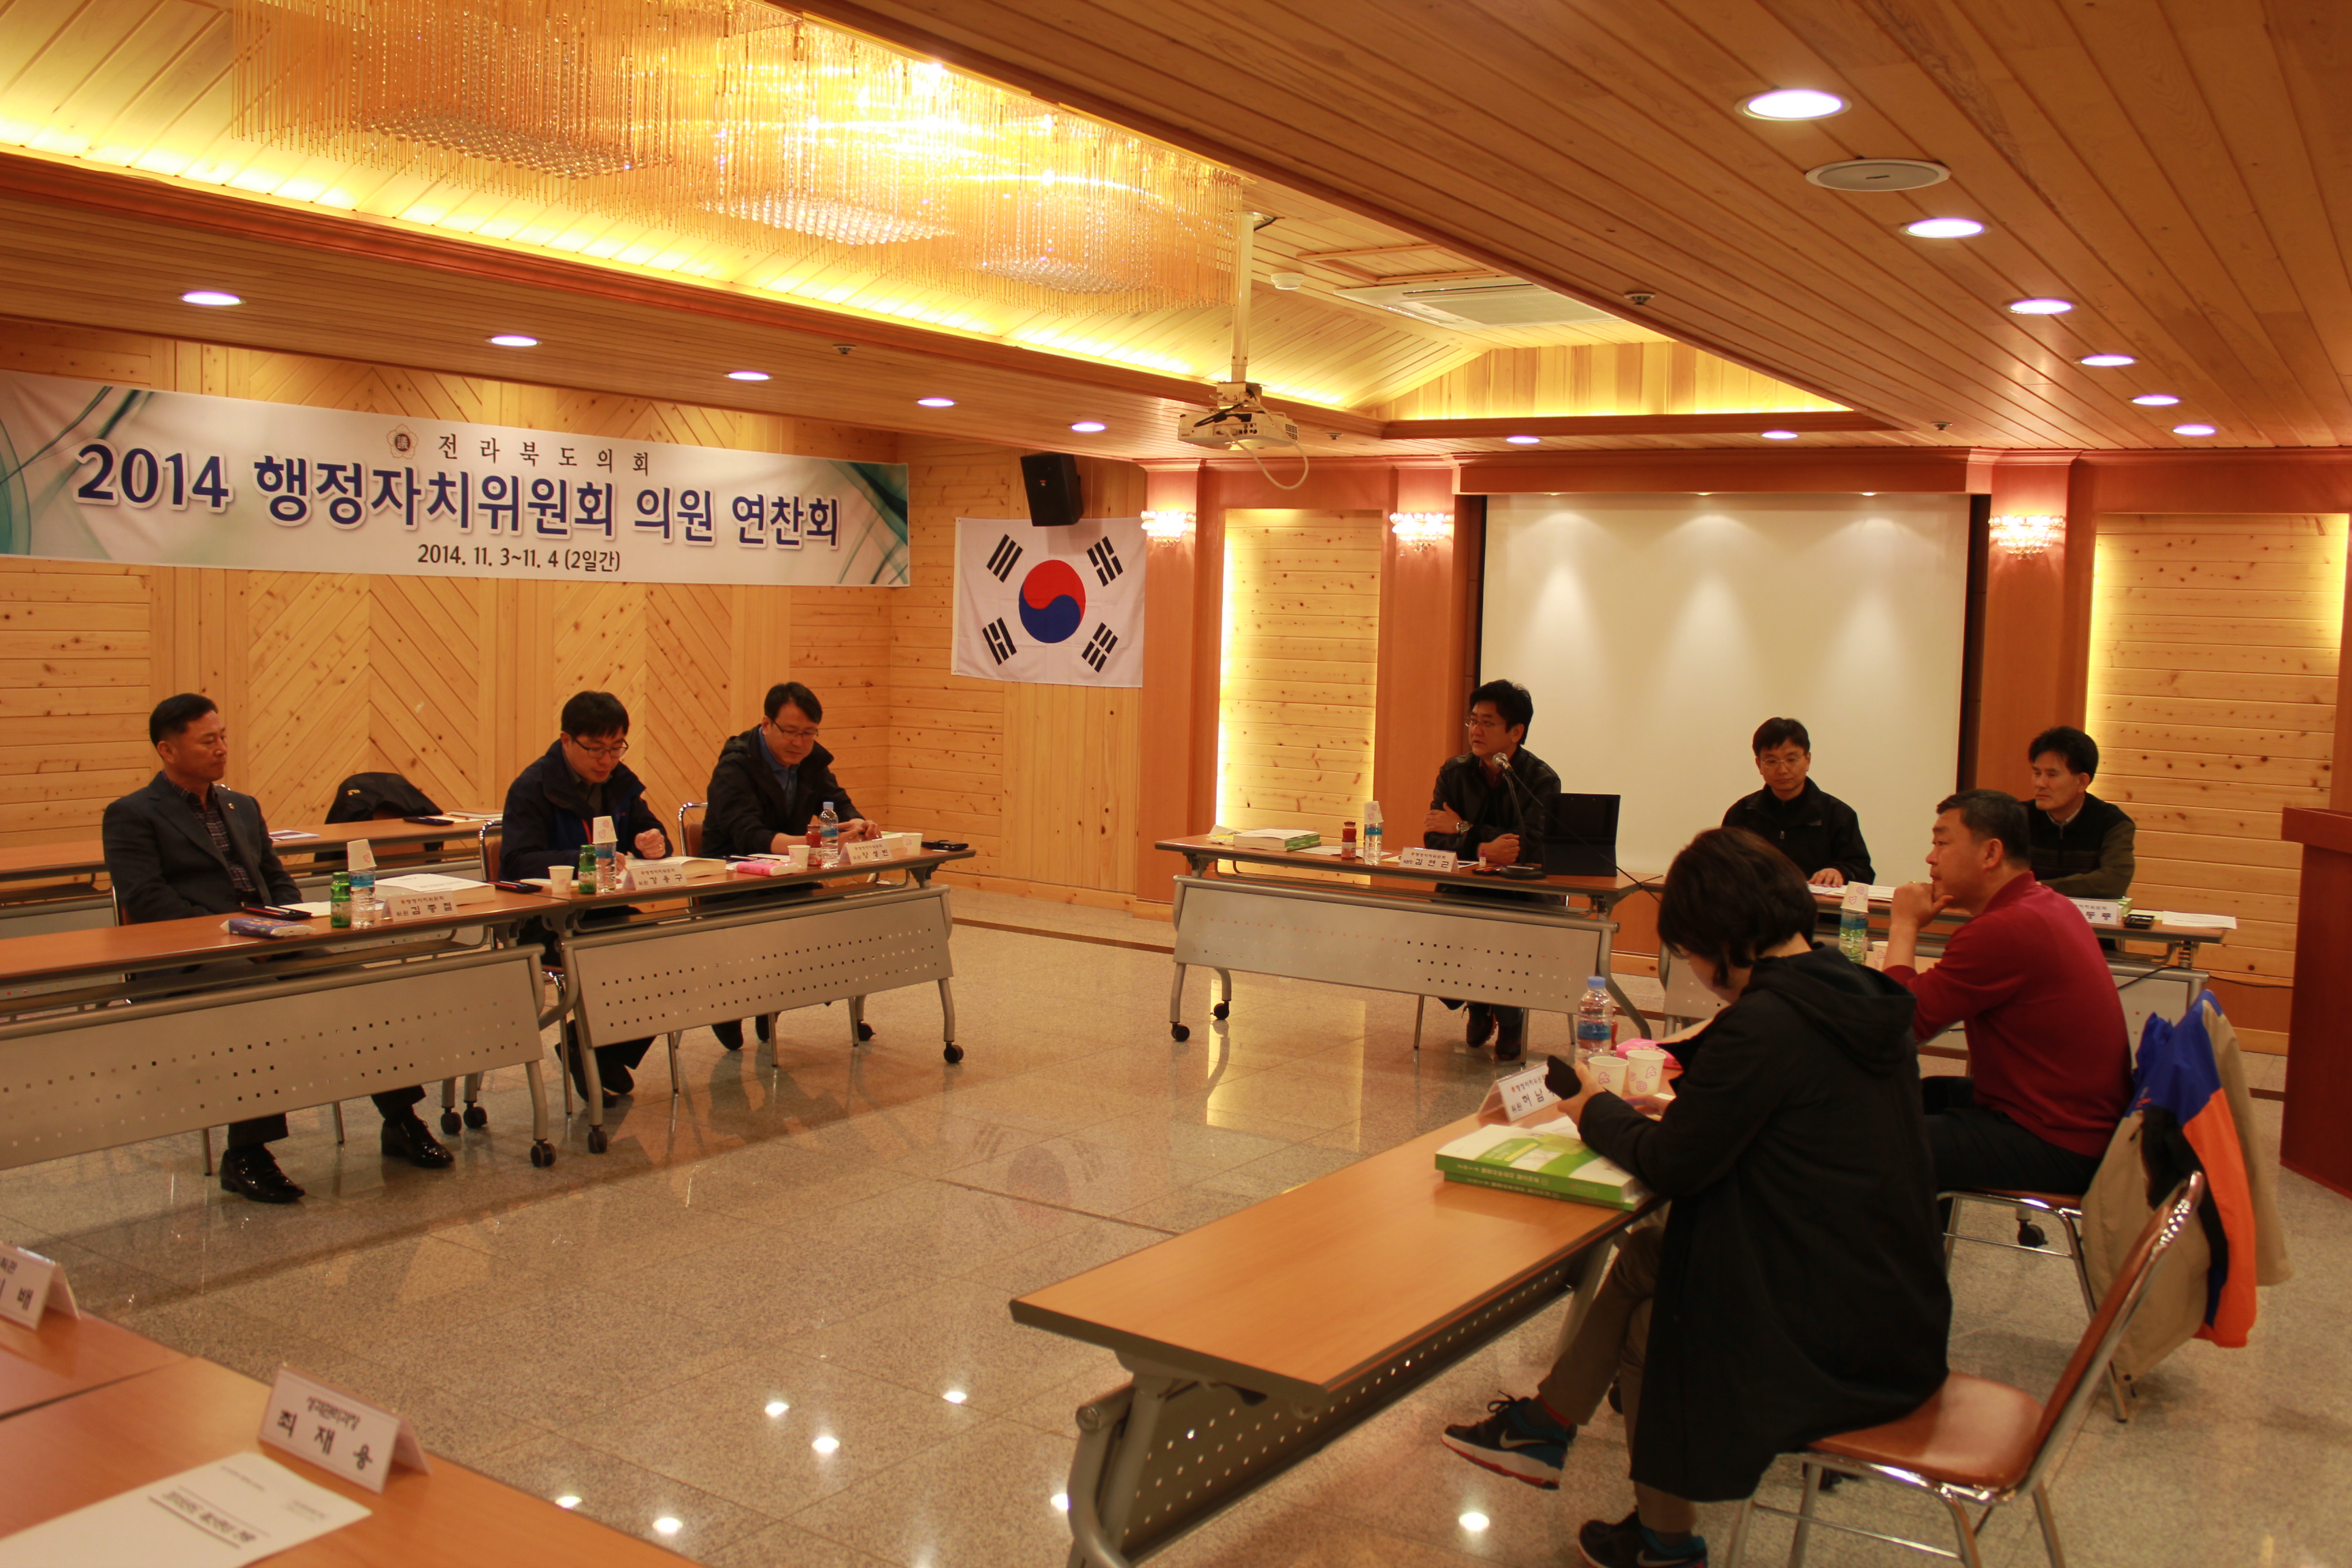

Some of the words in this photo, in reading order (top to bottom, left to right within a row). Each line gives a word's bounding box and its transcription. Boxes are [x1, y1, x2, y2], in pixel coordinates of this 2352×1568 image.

[438, 433, 649, 476] 전라북도의회
[76, 443, 230, 508] 2014
[254, 455, 615, 536] 행정자치위원회
[634, 487, 713, 542] 의원
[732, 493, 838, 546] 연찬회
[417, 544, 466, 566] 2014.
[474, 546, 493, 566] 11.
[500, 548, 540, 568] 3~11.
[548, 551, 559, 568] 4
[565, 549, 620, 572] (2일간)
[1415, 859, 1449, 868] 김연근
[276, 1409, 374, 1471] 최재용
